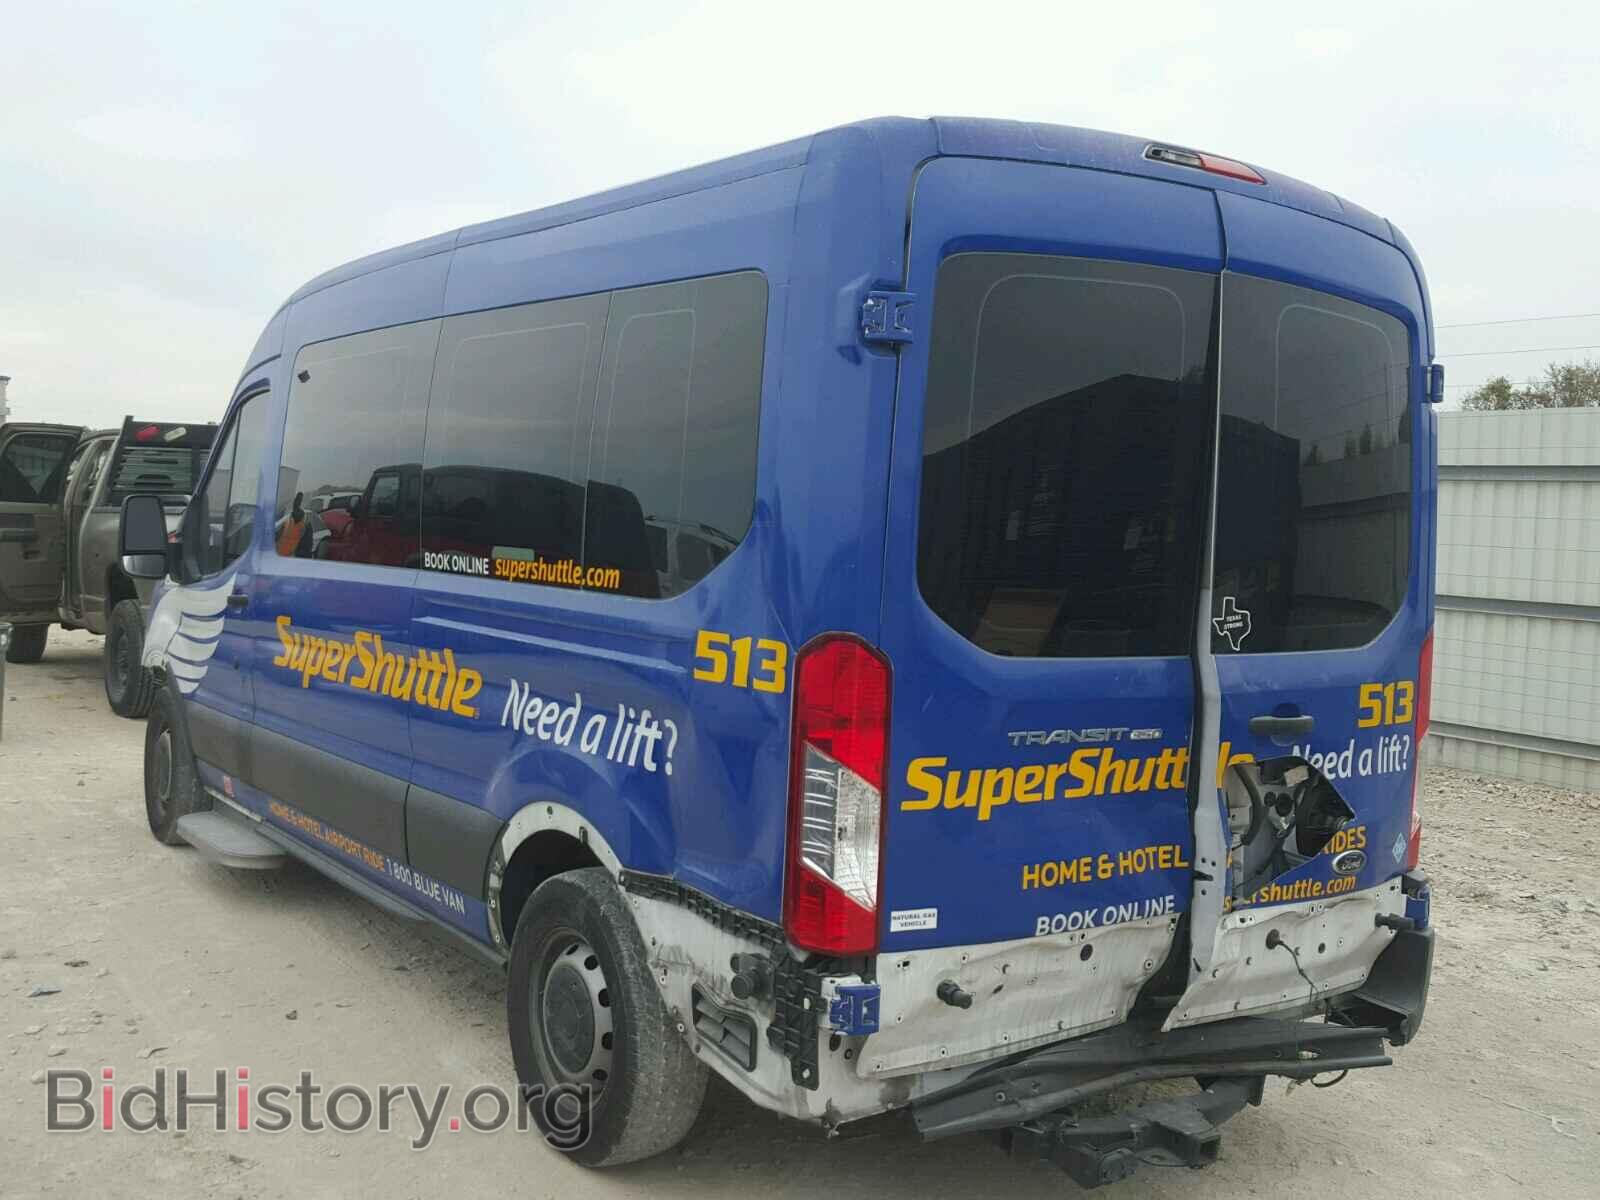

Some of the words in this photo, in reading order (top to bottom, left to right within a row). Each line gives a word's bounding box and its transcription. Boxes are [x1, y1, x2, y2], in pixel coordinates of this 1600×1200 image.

[424, 552, 450, 571] BOOK
[451, 555, 489, 575] ONLINE
[495, 558, 620, 589] supershuttle.com
[273, 615, 482, 718] SuperShuttle
[693, 629, 788, 693] 513
[501, 678, 582, 747] Need
[580, 713, 606, 754] a
[606, 703, 678, 775] lift?
[1358, 680, 1414, 728] 513
[1007, 728, 1130, 746] TRANSIT
[1358, 745, 1372, 776] a
[1377, 733, 1410, 775] lift?
[900, 741, 1254, 821] SuperShuttl
[1022, 856, 1093, 890] HOME
[1097, 854, 1115, 880] &
[1119, 845, 1190, 876] HOTEL
[1321, 825, 1367, 854] IDES
[414, 873, 441, 901] BLUE
[443, 887, 465, 915] VAN
[1035, 908, 1098, 937] BOOK
[1102, 895, 1175, 925] ONLINE
[892, 913, 920, 921] NATURAL
